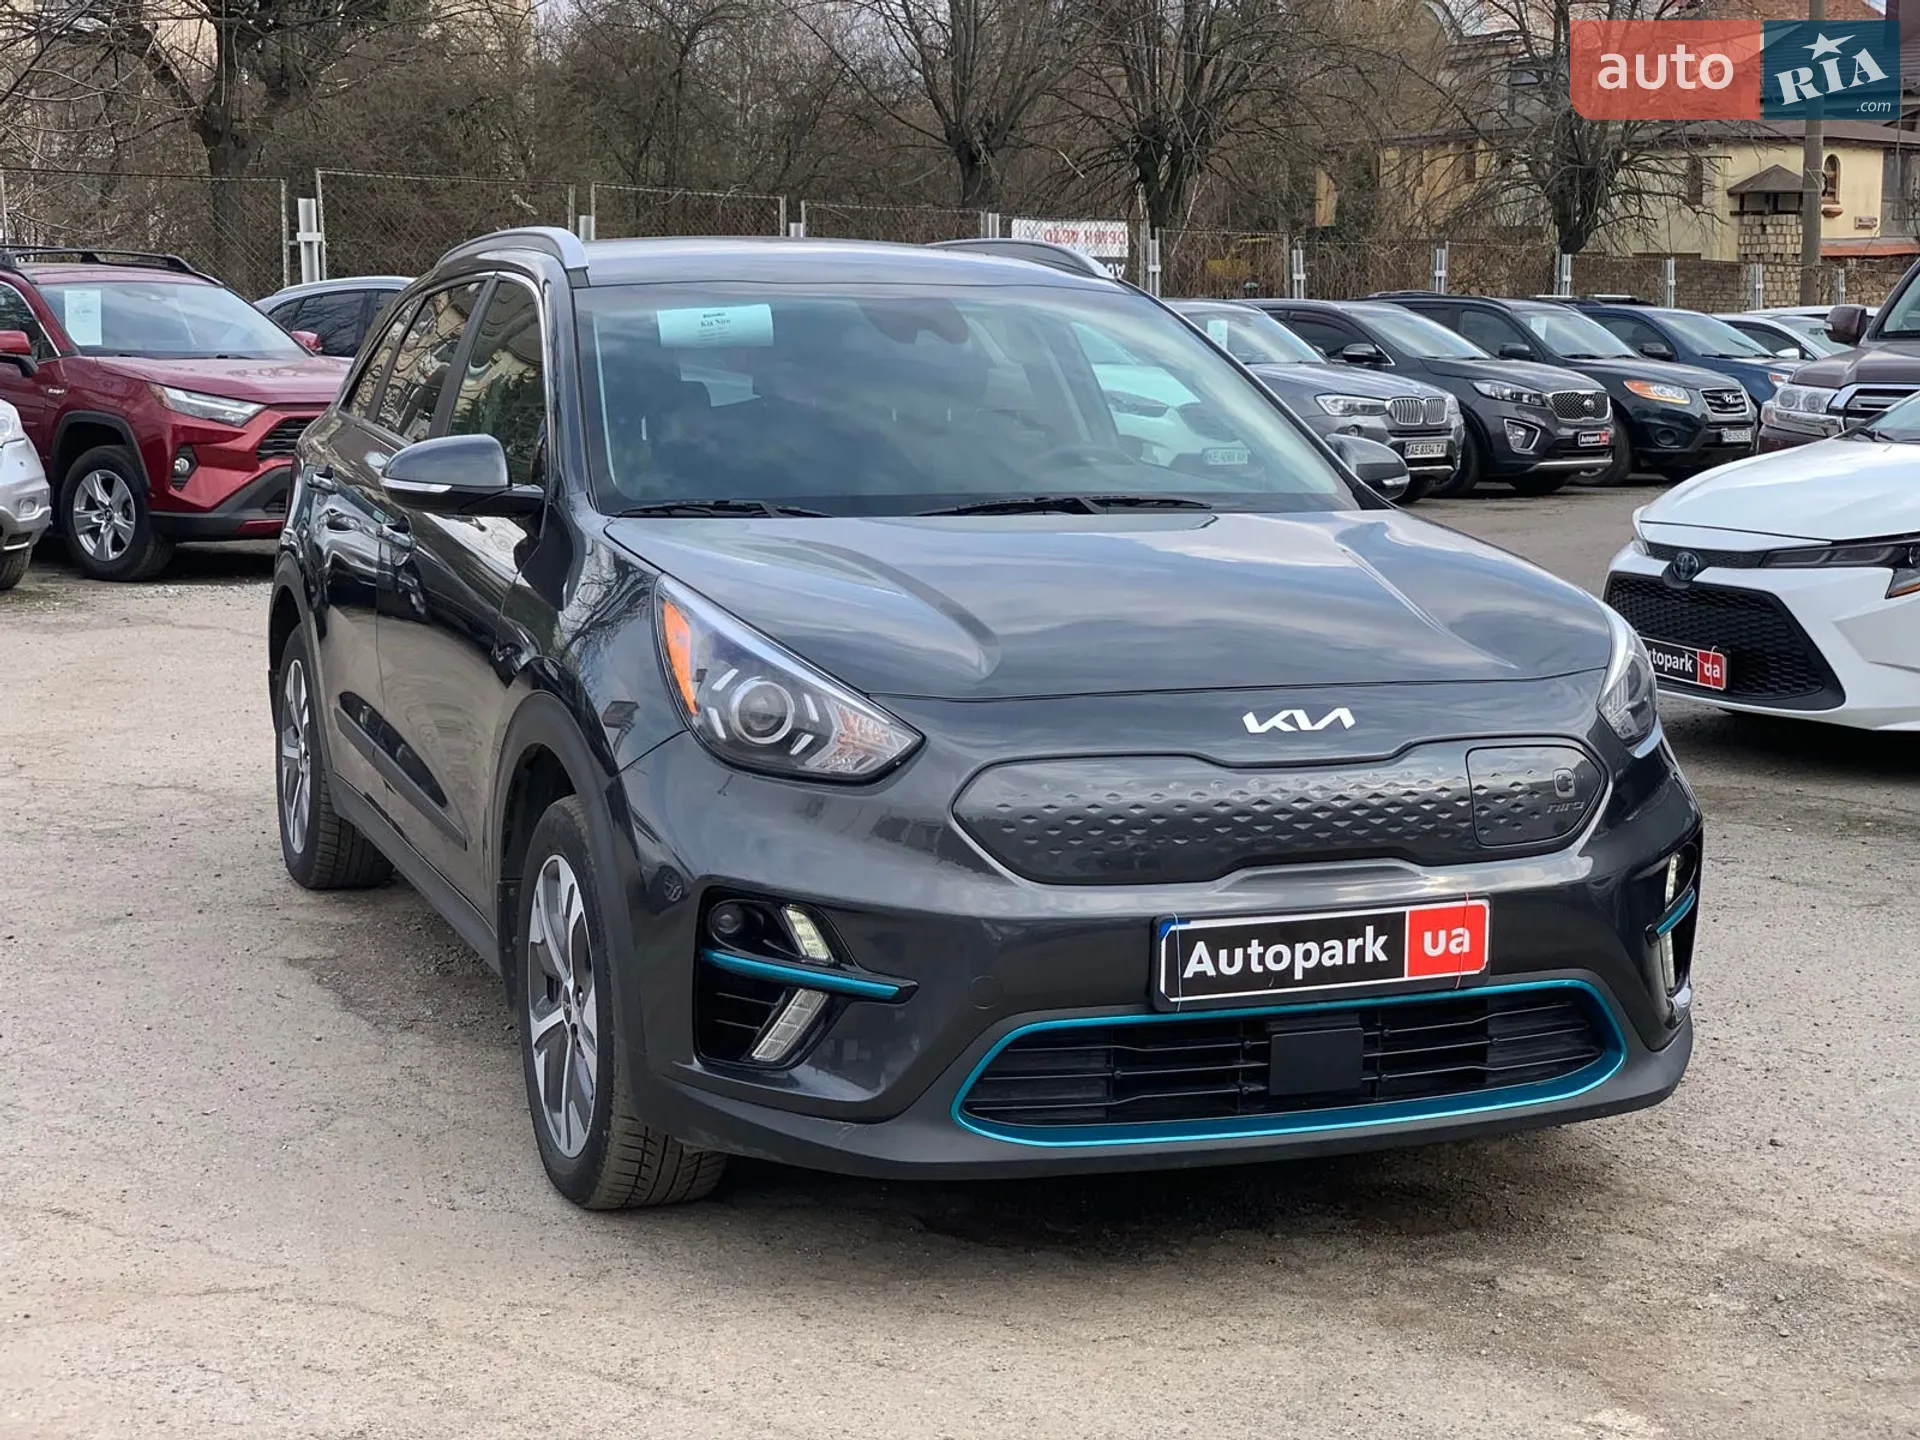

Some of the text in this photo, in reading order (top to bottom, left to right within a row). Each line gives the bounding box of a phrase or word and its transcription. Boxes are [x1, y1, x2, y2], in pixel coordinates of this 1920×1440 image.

[1648, 648, 1720, 678] topark ua
[1242, 707, 1356, 734] KIA
[1183, 922, 1471, 980] Autopark ua
